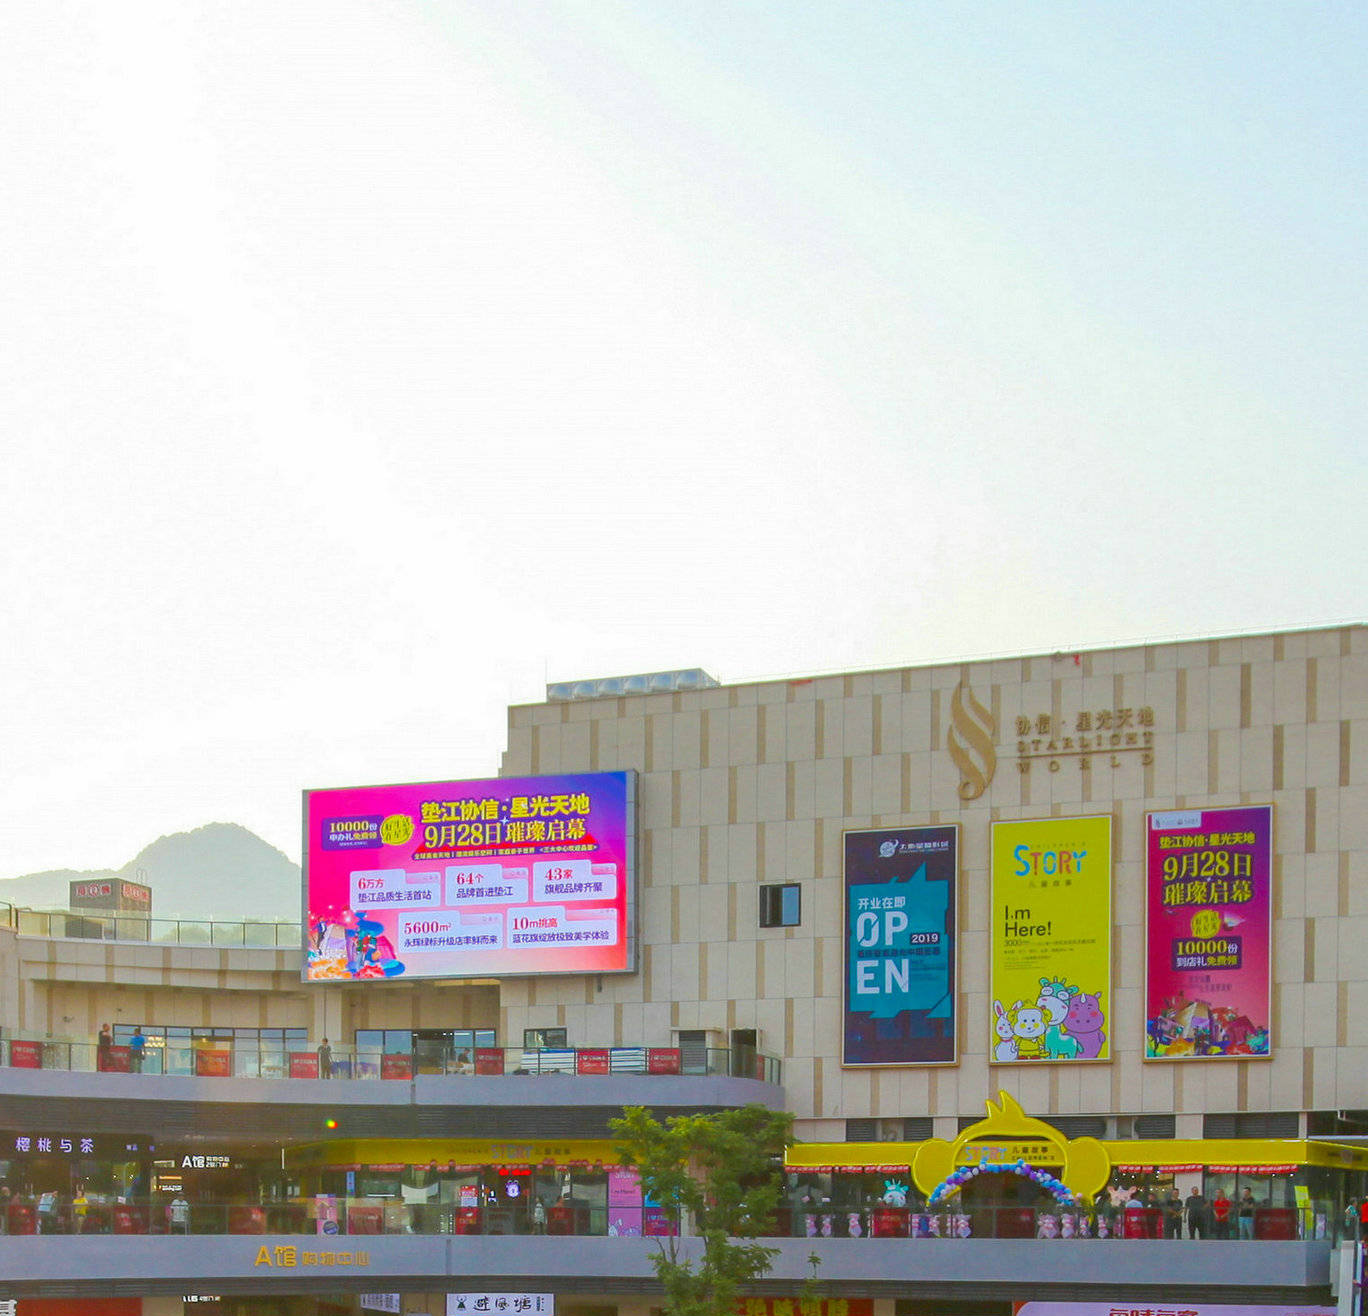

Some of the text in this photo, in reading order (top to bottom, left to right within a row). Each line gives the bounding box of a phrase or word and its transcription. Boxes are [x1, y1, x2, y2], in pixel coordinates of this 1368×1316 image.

[1015, 706, 1154, 736] 协信·星光天地
[1017, 731, 1154, 752] STARLIGHT
[1016, 753, 1154, 774] WORLD
[421, 793, 590, 823] 垫江协信·星光天地
[424, 817, 586, 848] 9月28日 璀璨启幕
[1014, 844, 1087, 876] STORY
[1163, 851, 1252, 881] 9月28日
[456, 873, 483, 885] 64个
[545, 868, 572, 881] 43家
[456, 886, 514, 899] 品牌首进垫江
[858, 896, 905, 910] 开业在即
[1163, 880, 1253, 905] 璀璨启幕
[857, 911, 908, 947] OP
[911, 933, 939, 943] 2019
[1004, 920, 1052, 937] Here!
[1177, 940, 1238, 956] 10000份
[856, 959, 909, 994] EN
[16, 1137, 94, 1153] 樱桃与茶
[182, 1155, 205, 1168] A馆
[254, 1246, 370, 1267] A馆 购物中心
[473, 1295, 532, 1313] 避风塘
